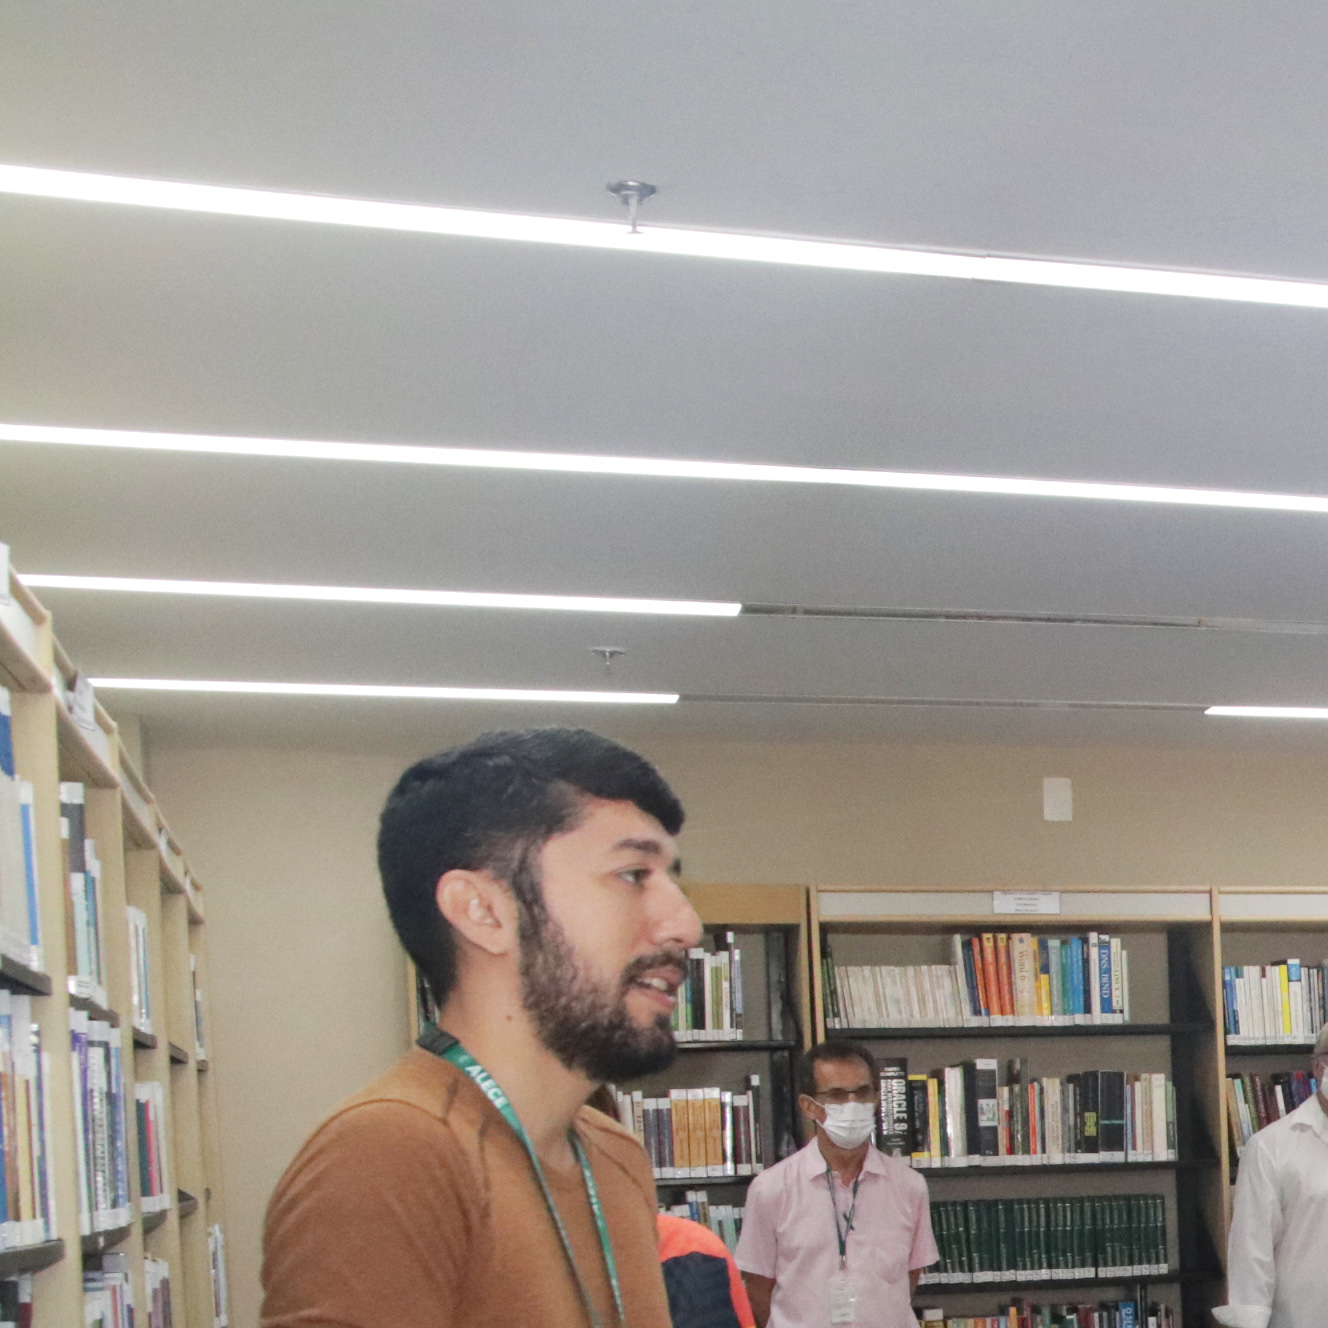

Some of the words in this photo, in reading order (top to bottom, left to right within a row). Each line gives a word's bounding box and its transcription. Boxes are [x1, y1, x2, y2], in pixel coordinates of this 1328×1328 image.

[1100, 950, 1109, 969] DNS
[1101, 974, 1110, 998] BIND
[465, 1064, 509, 1109] ALECE
[892, 1079, 907, 1120] ORACLE
